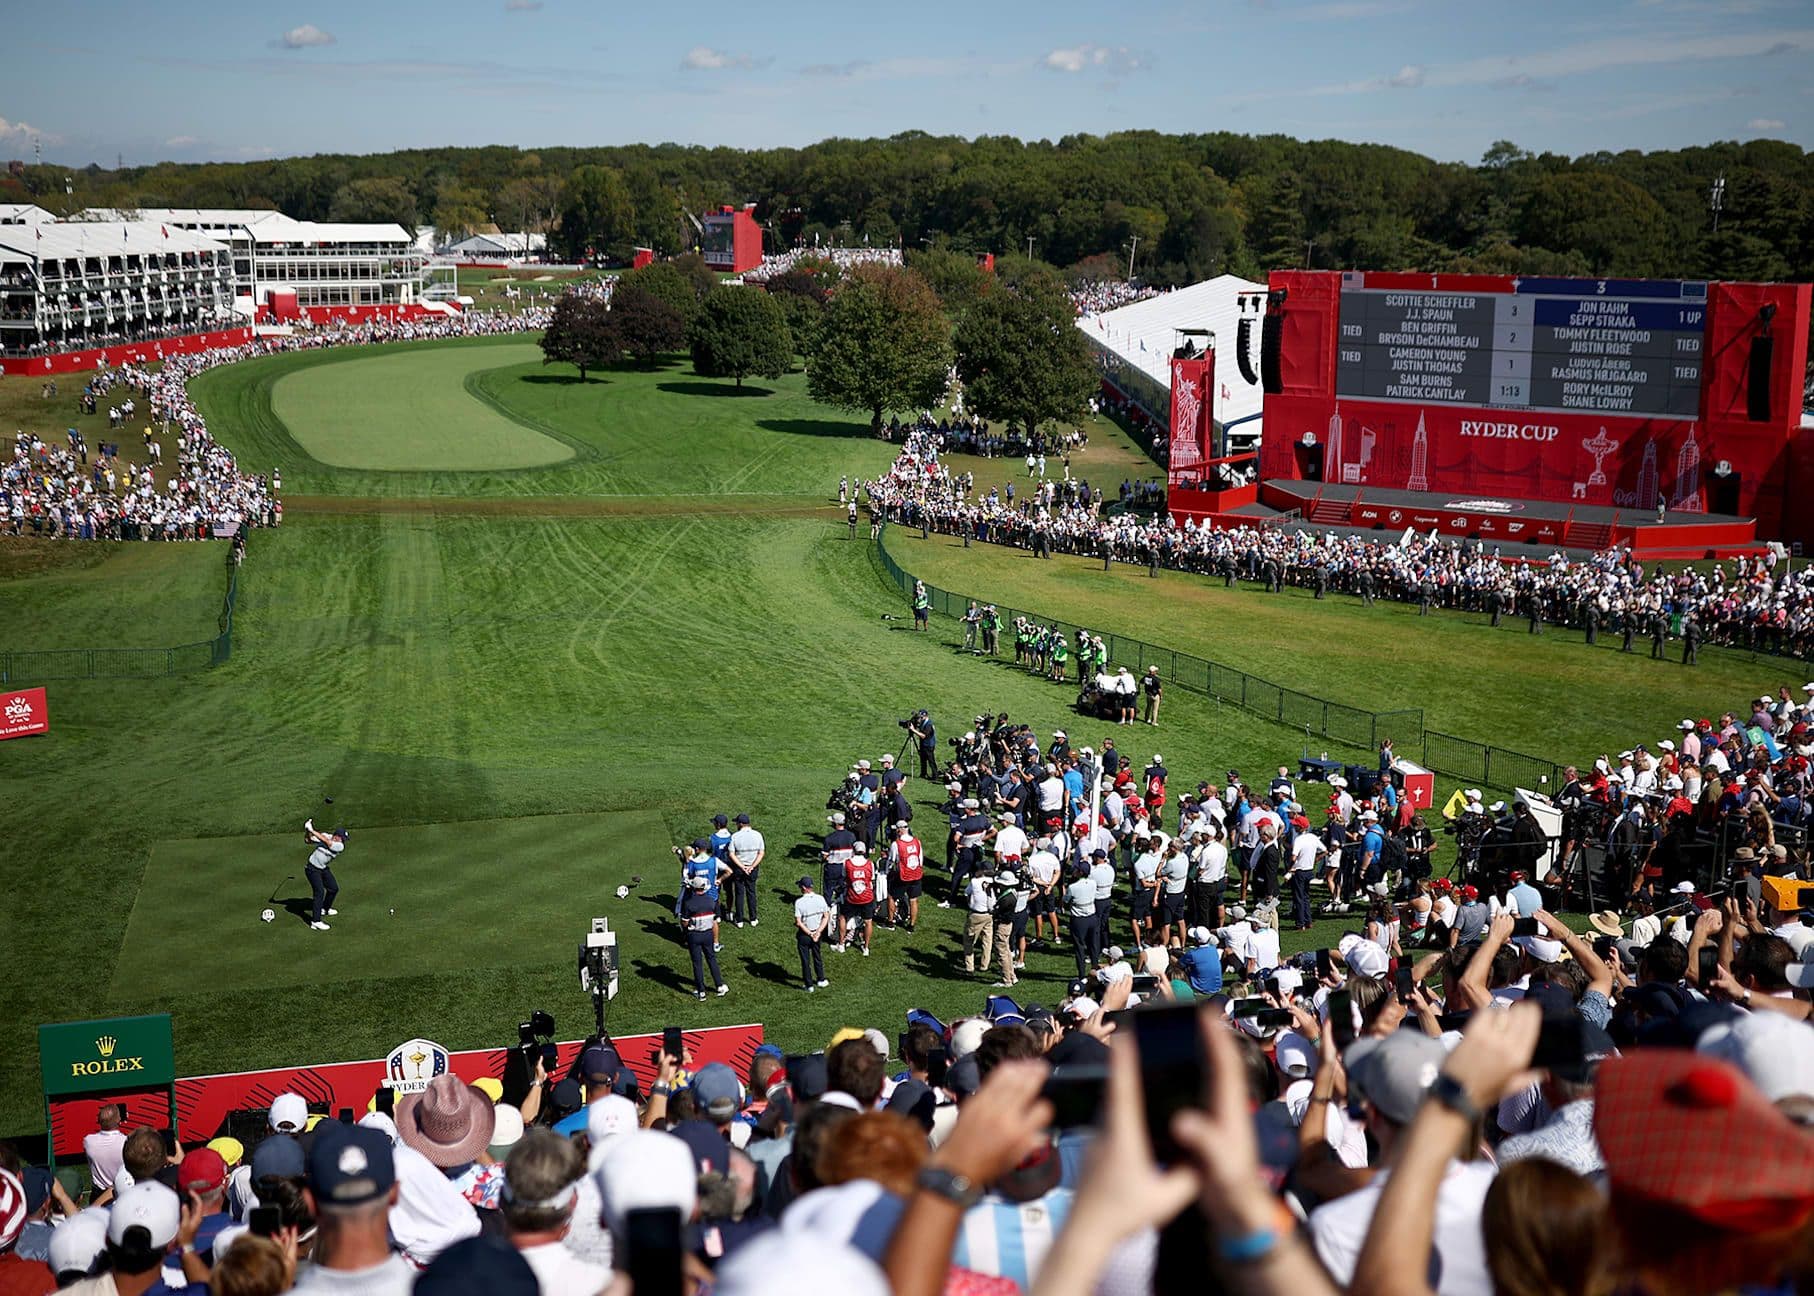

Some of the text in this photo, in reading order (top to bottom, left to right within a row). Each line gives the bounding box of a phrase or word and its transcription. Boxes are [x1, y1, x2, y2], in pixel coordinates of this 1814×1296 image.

[1432, 277, 1438, 289] 1
[1597, 282, 1606, 294] 3
[1386, 295, 1476, 309] SCOTTIE SCHEFFLER
[1578, 301, 1629, 315] JON RAHM
[1406, 309, 1453, 321] J.J. SPAUN
[1511, 305, 1518, 317] 3
[1679, 311, 1702, 324] 1 UP
[1570, 314, 1636, 328] SEPP STRAKA
[1343, 325, 1362, 336] TIED
[1401, 322, 1457, 334] BEN GRIFFIN
[1378, 333, 1479, 348] BRYSON DeCHAMBEAU
[1510, 332, 1516, 343] 2
[1554, 328, 1650, 343] TOMMY FLEETWOOD
[1570, 341, 1632, 355] JUSTIN ROSE
[1676, 338, 1699, 351] TIED
[1342, 351, 1361, 362] TIED
[1389, 348, 1466, 362] CAMERON YOUNG
[1392, 360, 1463, 374] JUSTIN THOMAS
[1509, 360, 1513, 369] 1
[1569, 356, 1631, 370] LUDVIG ÅBERG
[1552, 369, 1648, 383] RASMUS HØJGAARD
[1674, 366, 1697, 379] TIED
[1400, 374, 1452, 387] SAM BURNS
[1386, 386, 1466, 400] PATRICK CANTLAY
[1501, 385, 1520, 397] 1:13
[1564, 382, 1634, 397] RORY McILROY
[1562, 395, 1633, 409] SHANE LOWRY
[1460, 420, 1559, 441] RYDER CUP
[1362, 510, 1377, 519] AON
[4, 704, 32, 716] PGA
[71, 1056, 144, 1076] ROLEX
